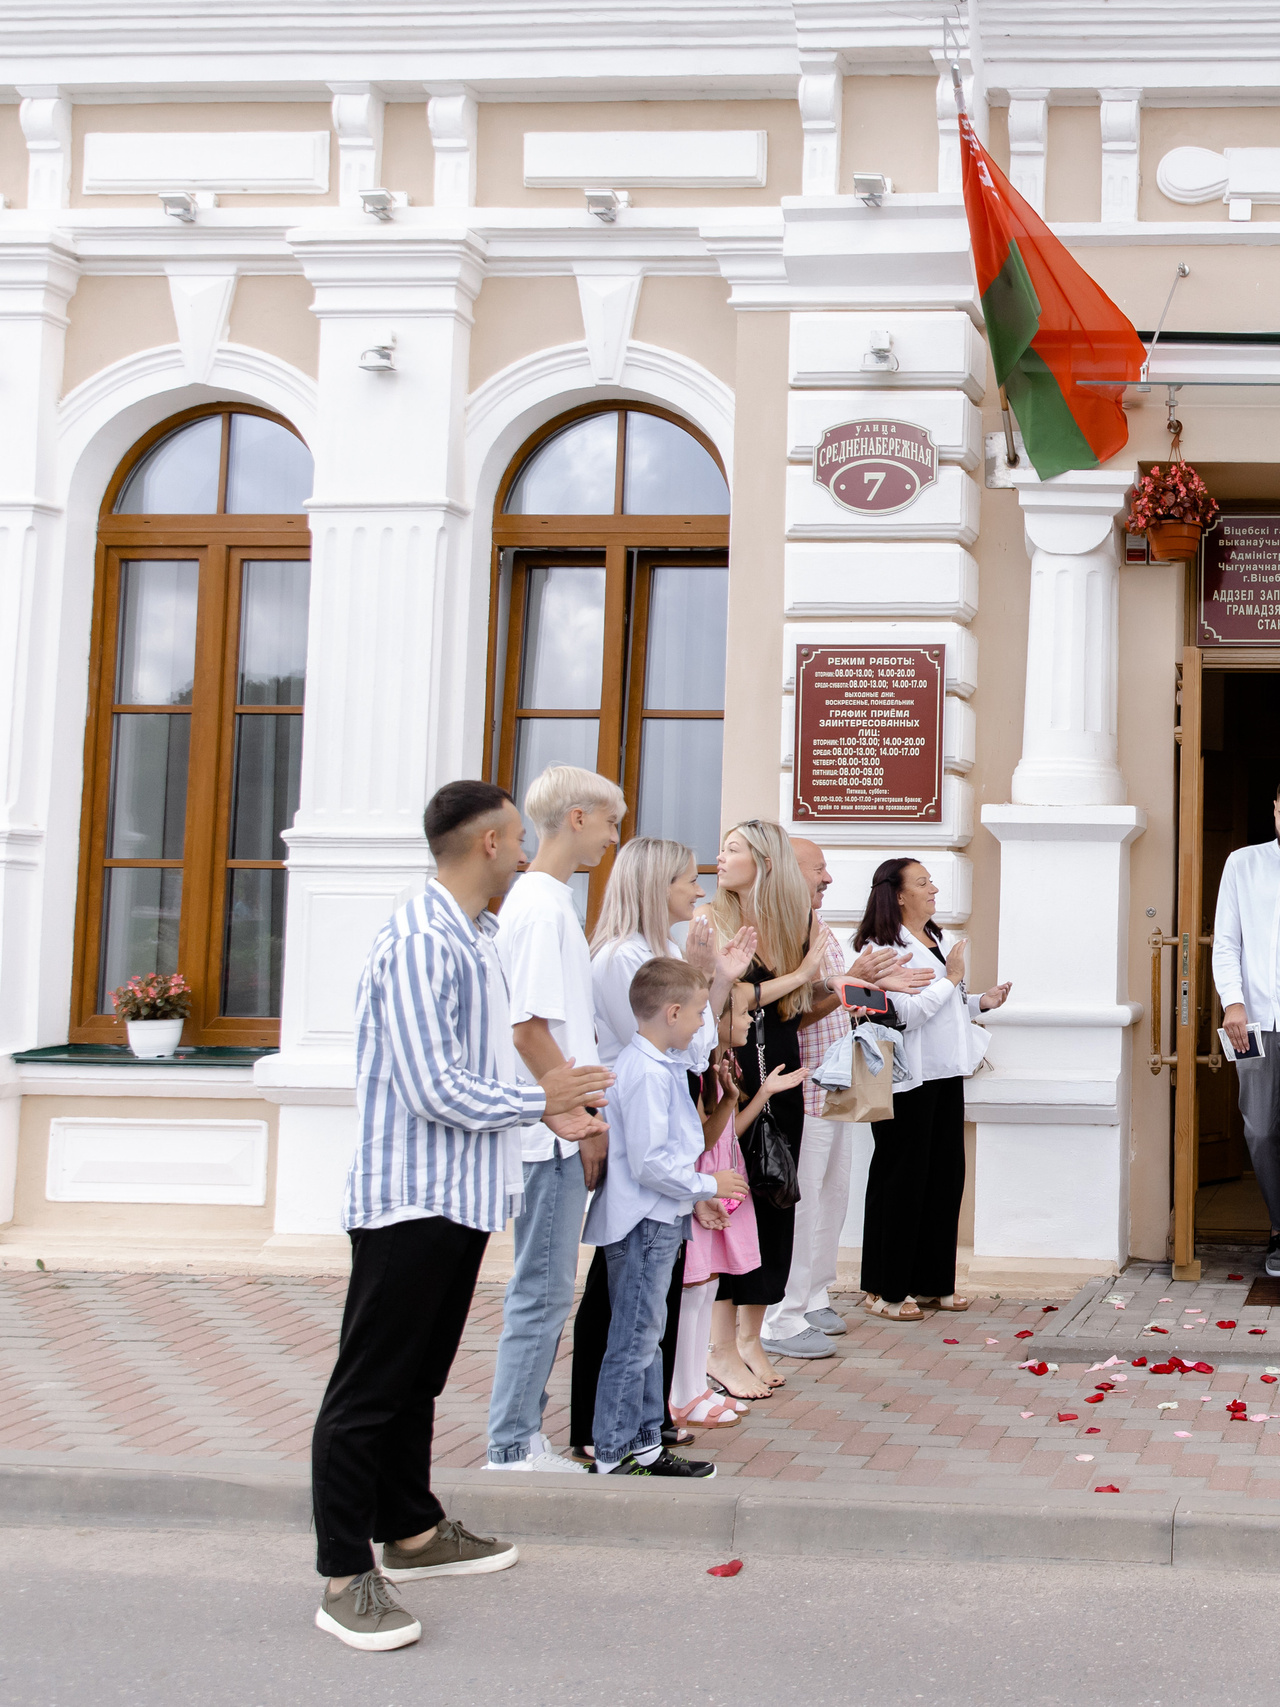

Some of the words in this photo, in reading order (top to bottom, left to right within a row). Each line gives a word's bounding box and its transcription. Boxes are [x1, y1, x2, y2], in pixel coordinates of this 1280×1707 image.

[856, 424, 896, 436] улица
[820, 437, 932, 468] СРЕДНЕНАБЕРЕЖНАЯ
[864, 472, 886, 501] 7
[1224, 526, 1269, 536] Віцебскі
[1219, 539, 1280, 548] выканаўчы
[1213, 590, 1254, 603] АДДЗЕЛ
[828, 657, 865, 665] РЕЖИМ
[870, 657, 915, 665] РАБОТЫ:
[878, 669, 915, 677] 14.00-20.00
[892, 680, 928, 688] 14.00-17.00
[871, 708, 910, 717] ПРИЁМА
[858, 729, 880, 737] ЛИЦ:
[883, 738, 925, 746] 14.00-20.00
[880, 748, 919, 756] 14.00-17.00
